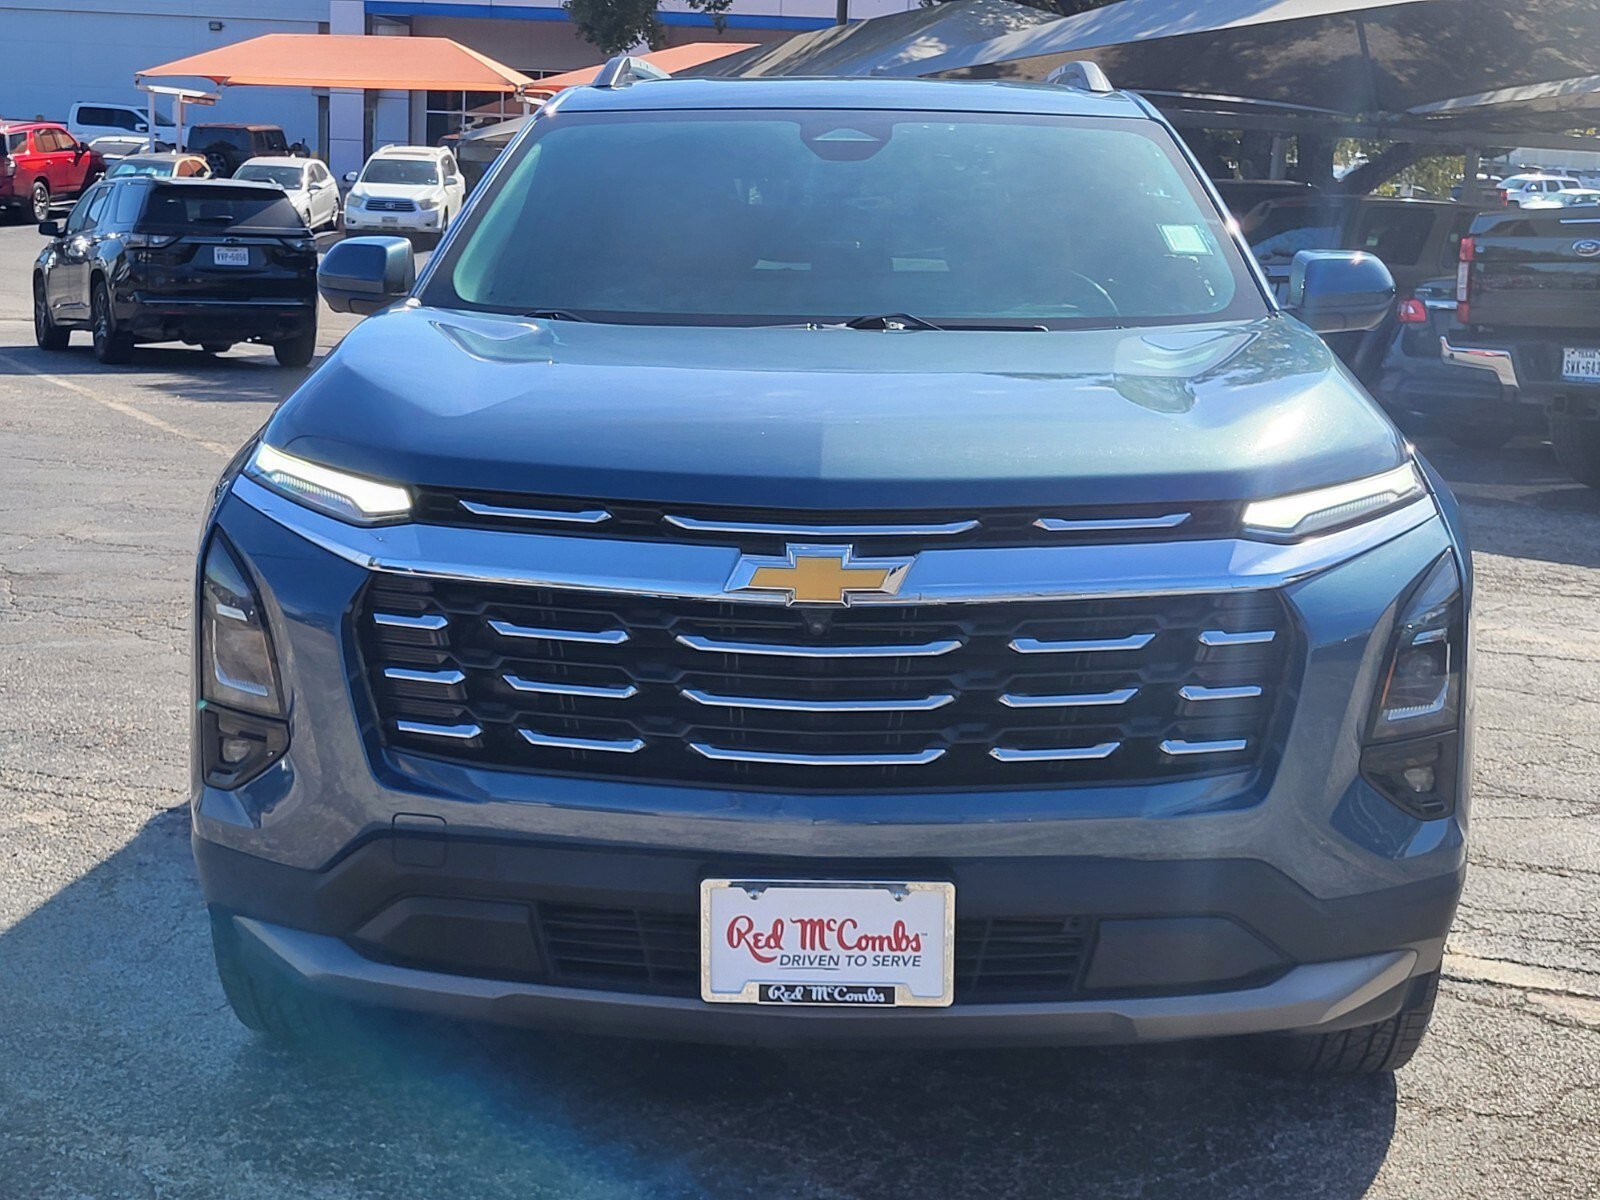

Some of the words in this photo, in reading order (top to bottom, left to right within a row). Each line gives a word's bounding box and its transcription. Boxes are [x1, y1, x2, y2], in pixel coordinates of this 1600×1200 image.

[727, 915, 784, 963] Red
[790, 917, 922, 952] McCombs
[779, 954, 840, 967] DRIVEN
[845, 955, 868, 967] TO
[872, 955, 922, 967] SERVE
[767, 984, 804, 1003] Red
[806, 985, 885, 1003] McCombs
